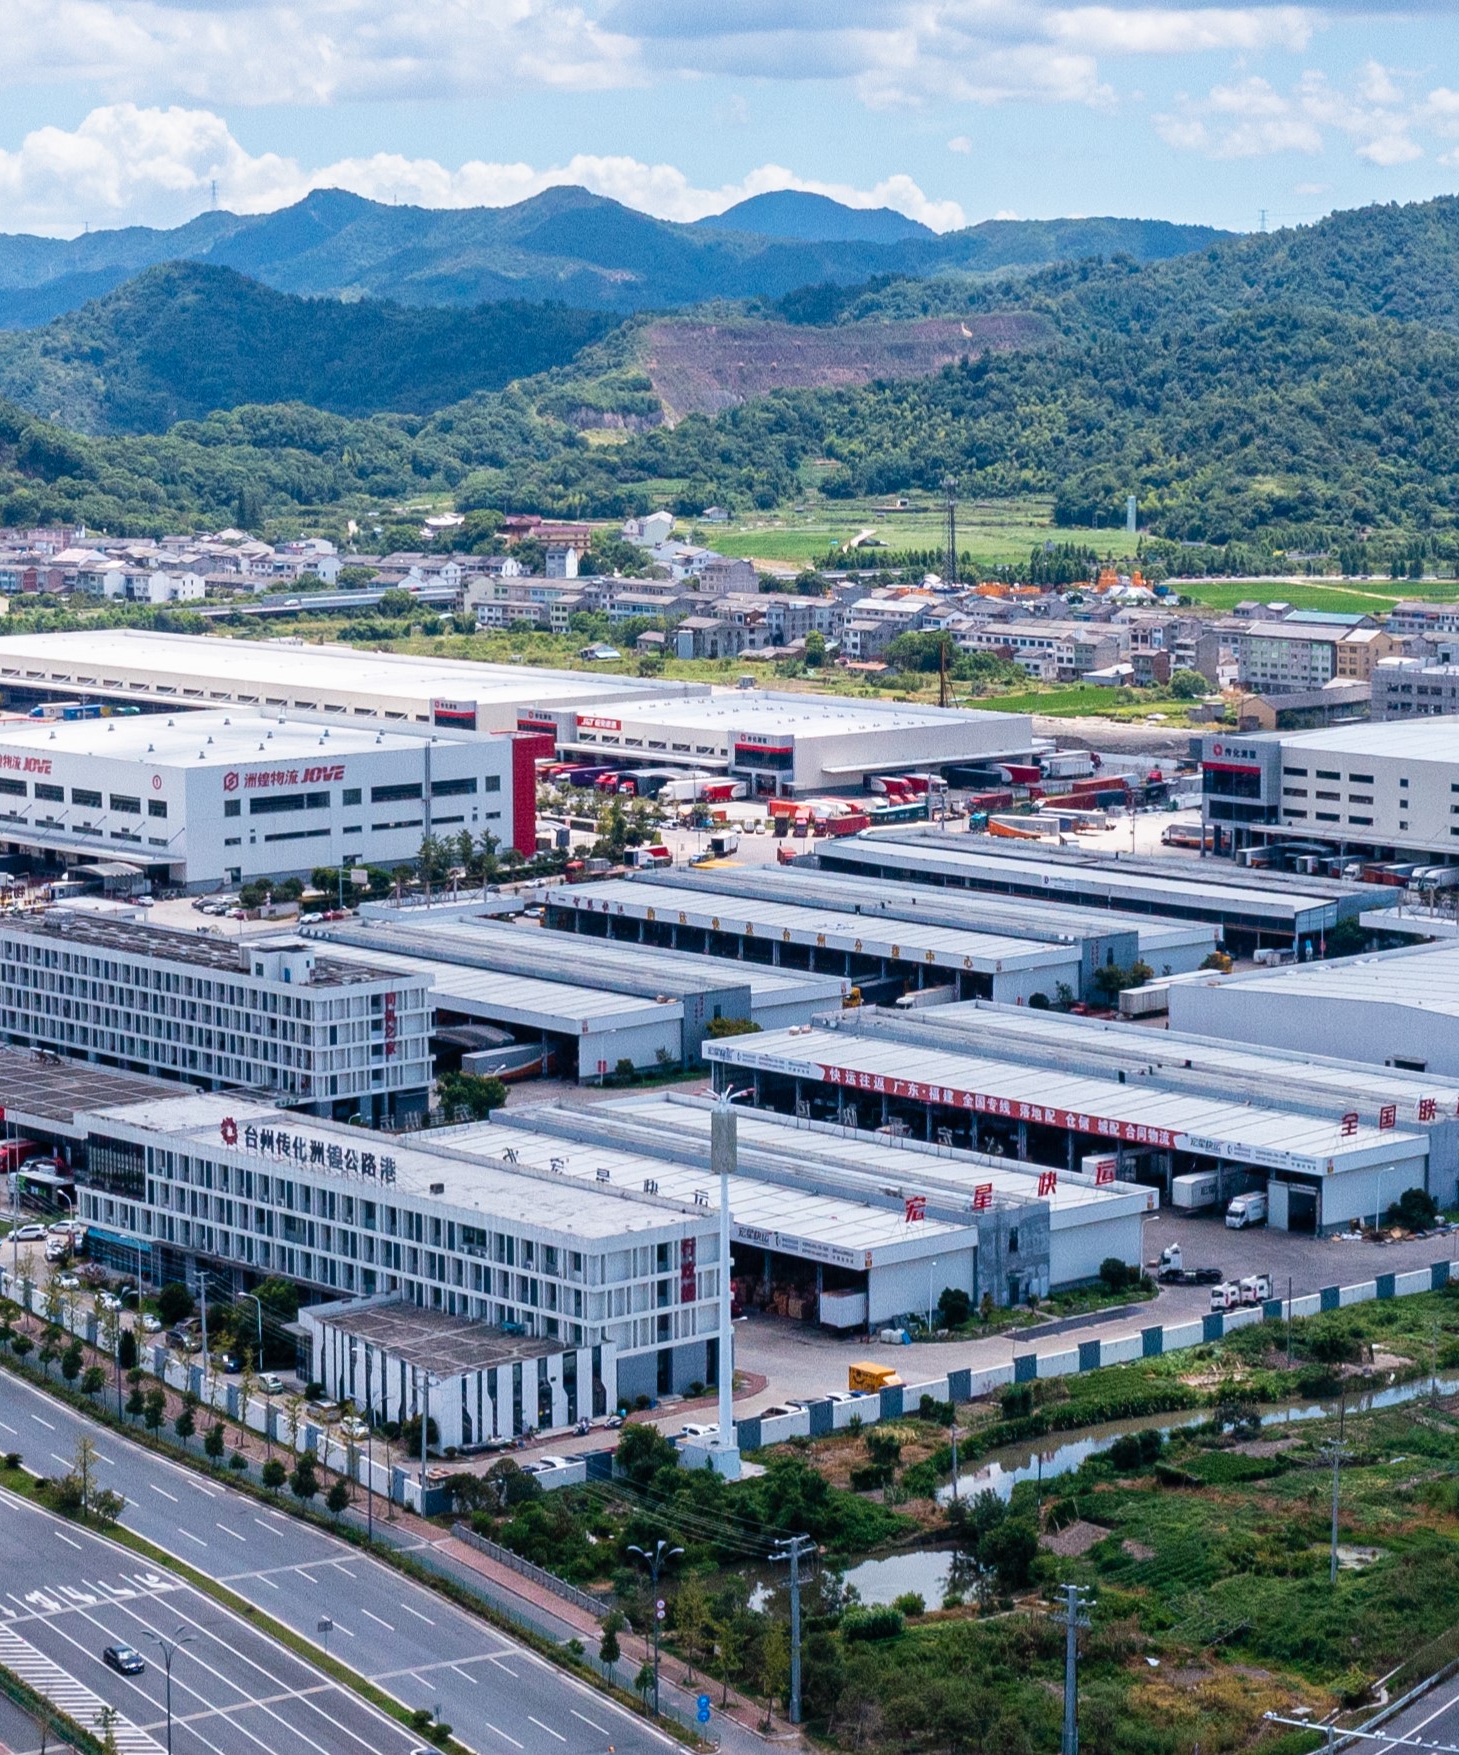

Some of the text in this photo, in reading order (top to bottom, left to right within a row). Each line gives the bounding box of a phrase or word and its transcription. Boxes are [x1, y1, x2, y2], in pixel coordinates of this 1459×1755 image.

[301, 765, 345, 783] JOVE
[829, 1067, 885, 1091] 快运往返
[893, 1080, 954, 1105] 广东·福建
[962, 1093, 1011, 1115] 全国专线
[1019, 1103, 1056, 1124] 落地配
[1125, 1125, 1170, 1146] 合同物流
[905, 1160, 1117, 1223] 宏星快运
